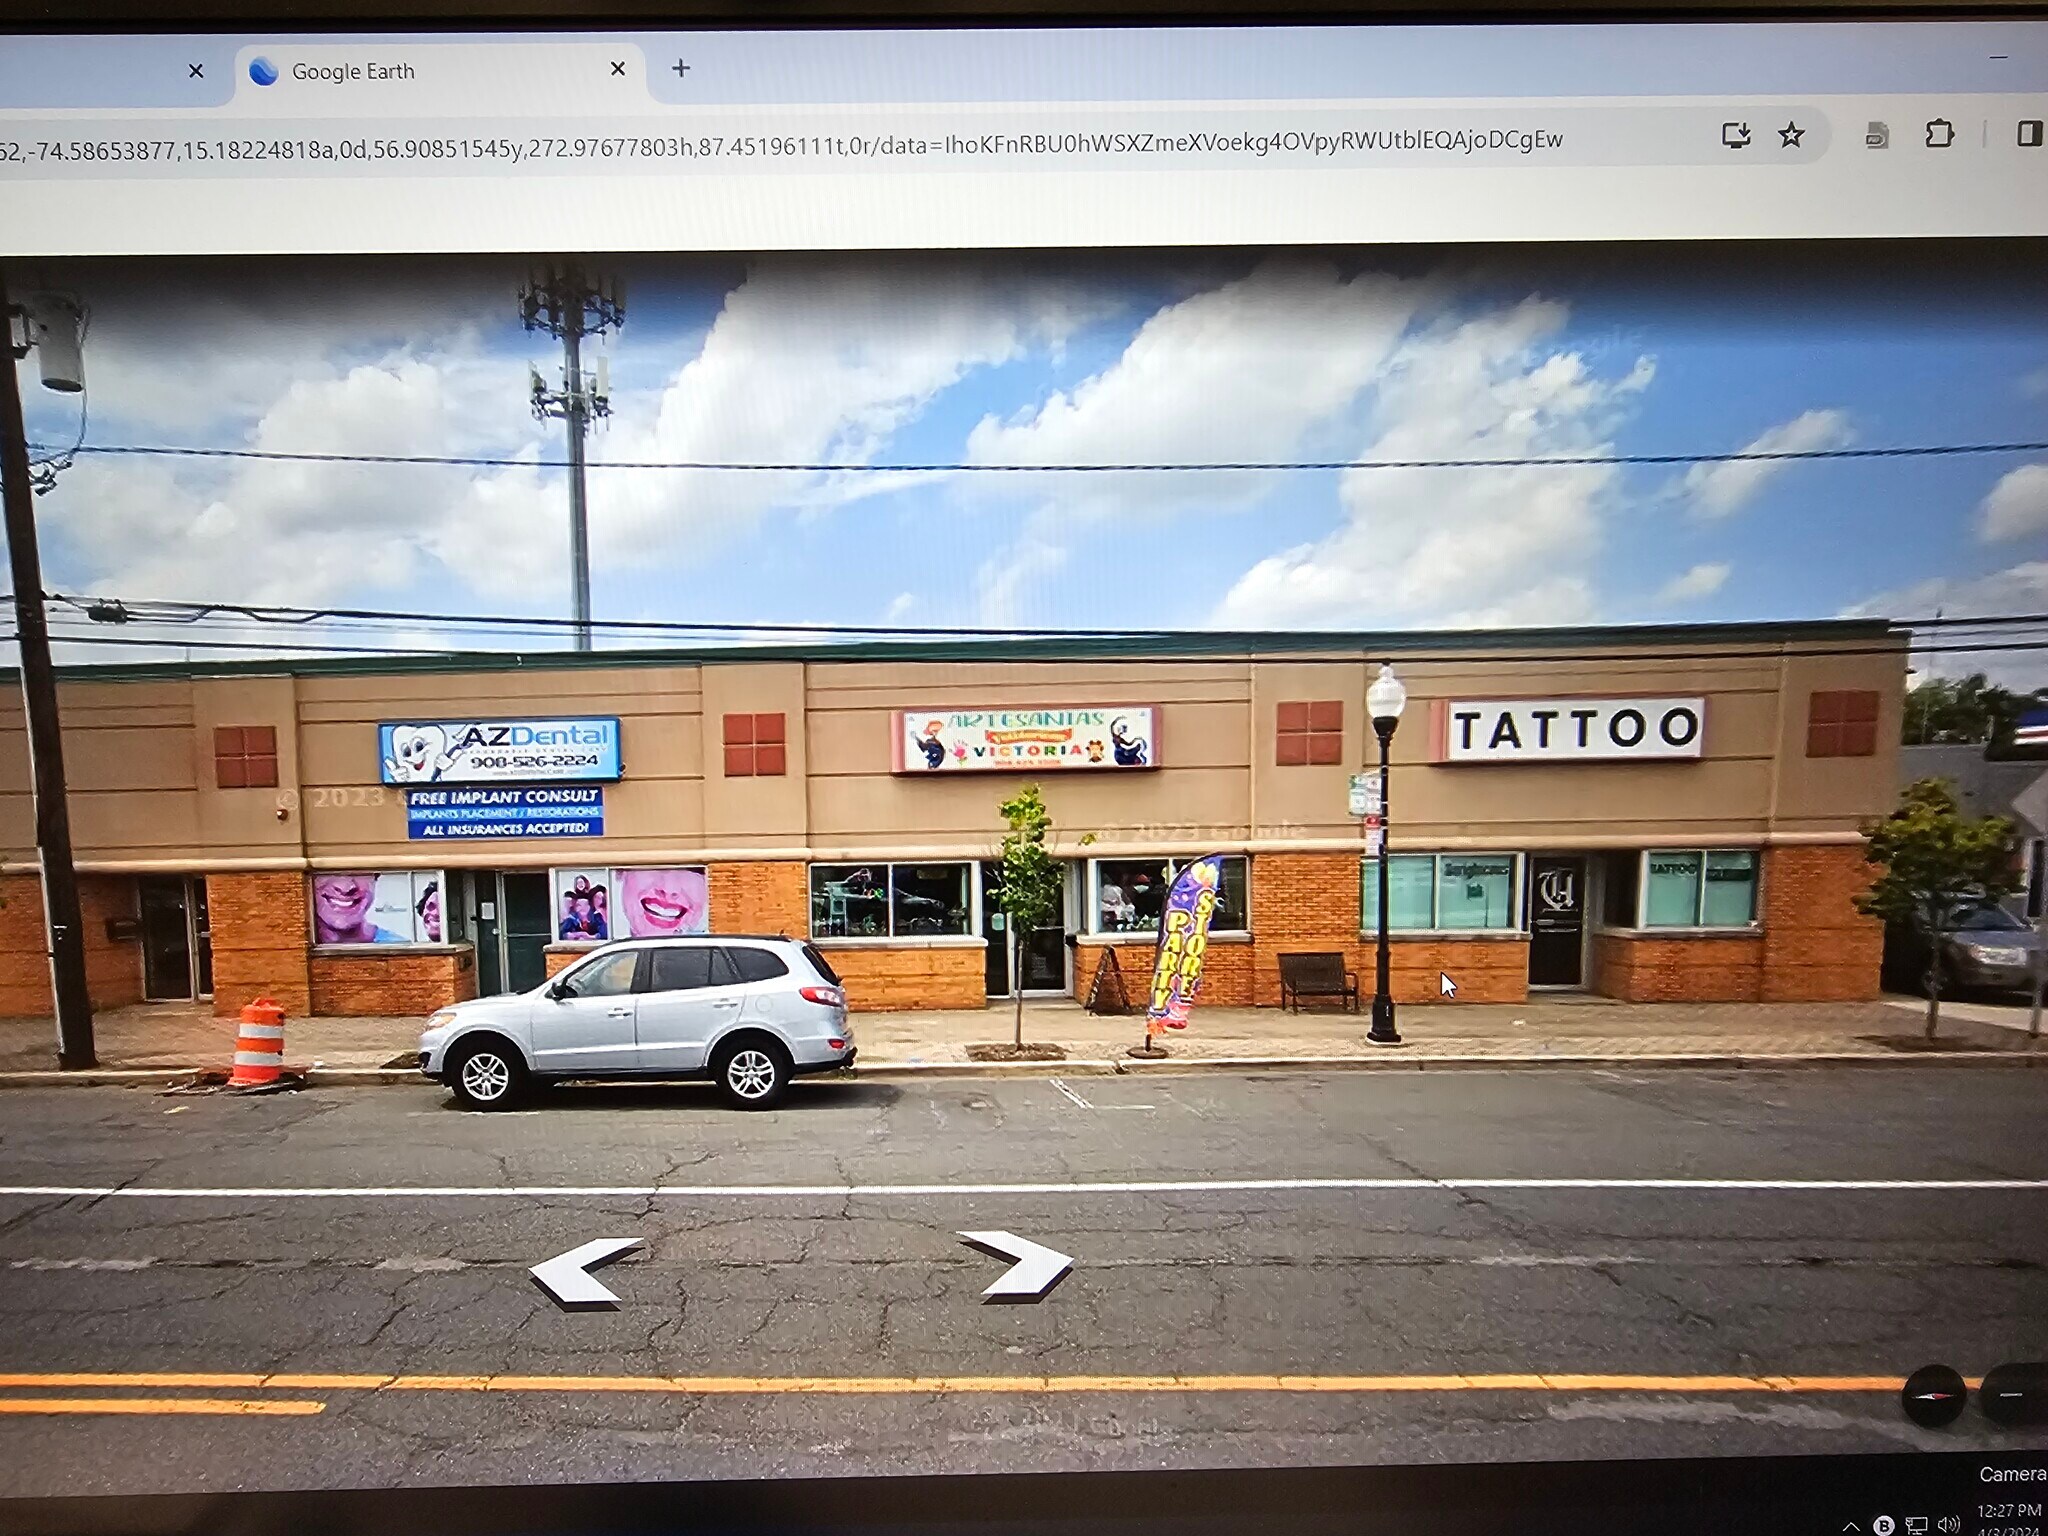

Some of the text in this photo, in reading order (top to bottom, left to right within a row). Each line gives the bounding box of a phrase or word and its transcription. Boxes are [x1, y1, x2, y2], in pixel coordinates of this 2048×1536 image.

[293, 63, 415, 84] Google Earth
[948, 711, 1104, 728] ARTESANIAS
[1454, 706, 1699, 749] TATTOO
[462, 725, 608, 747] AZDental
[973, 745, 1083, 757] VICTORIA
[471, 755, 599, 769] 908-526-2224
[410, 792, 447, 805] FREE
[450, 791, 521, 804] IMPLANT
[525, 790, 598, 803] CONSULT
[410, 808, 459, 819] IMPLANTS
[461, 808, 518, 818] PLACEMENT
[527, 807, 600, 817] RESTORATIONS
[423, 823, 589, 835] ALL INSURANCES ACCEPTED!
[1179, 890, 1215, 997] STORE
[1152, 911, 1192, 1010] PARTY
[1980, 1466, 2047, 1482] Camera
[1978, 1503, 2042, 1518] 12:27 PM
